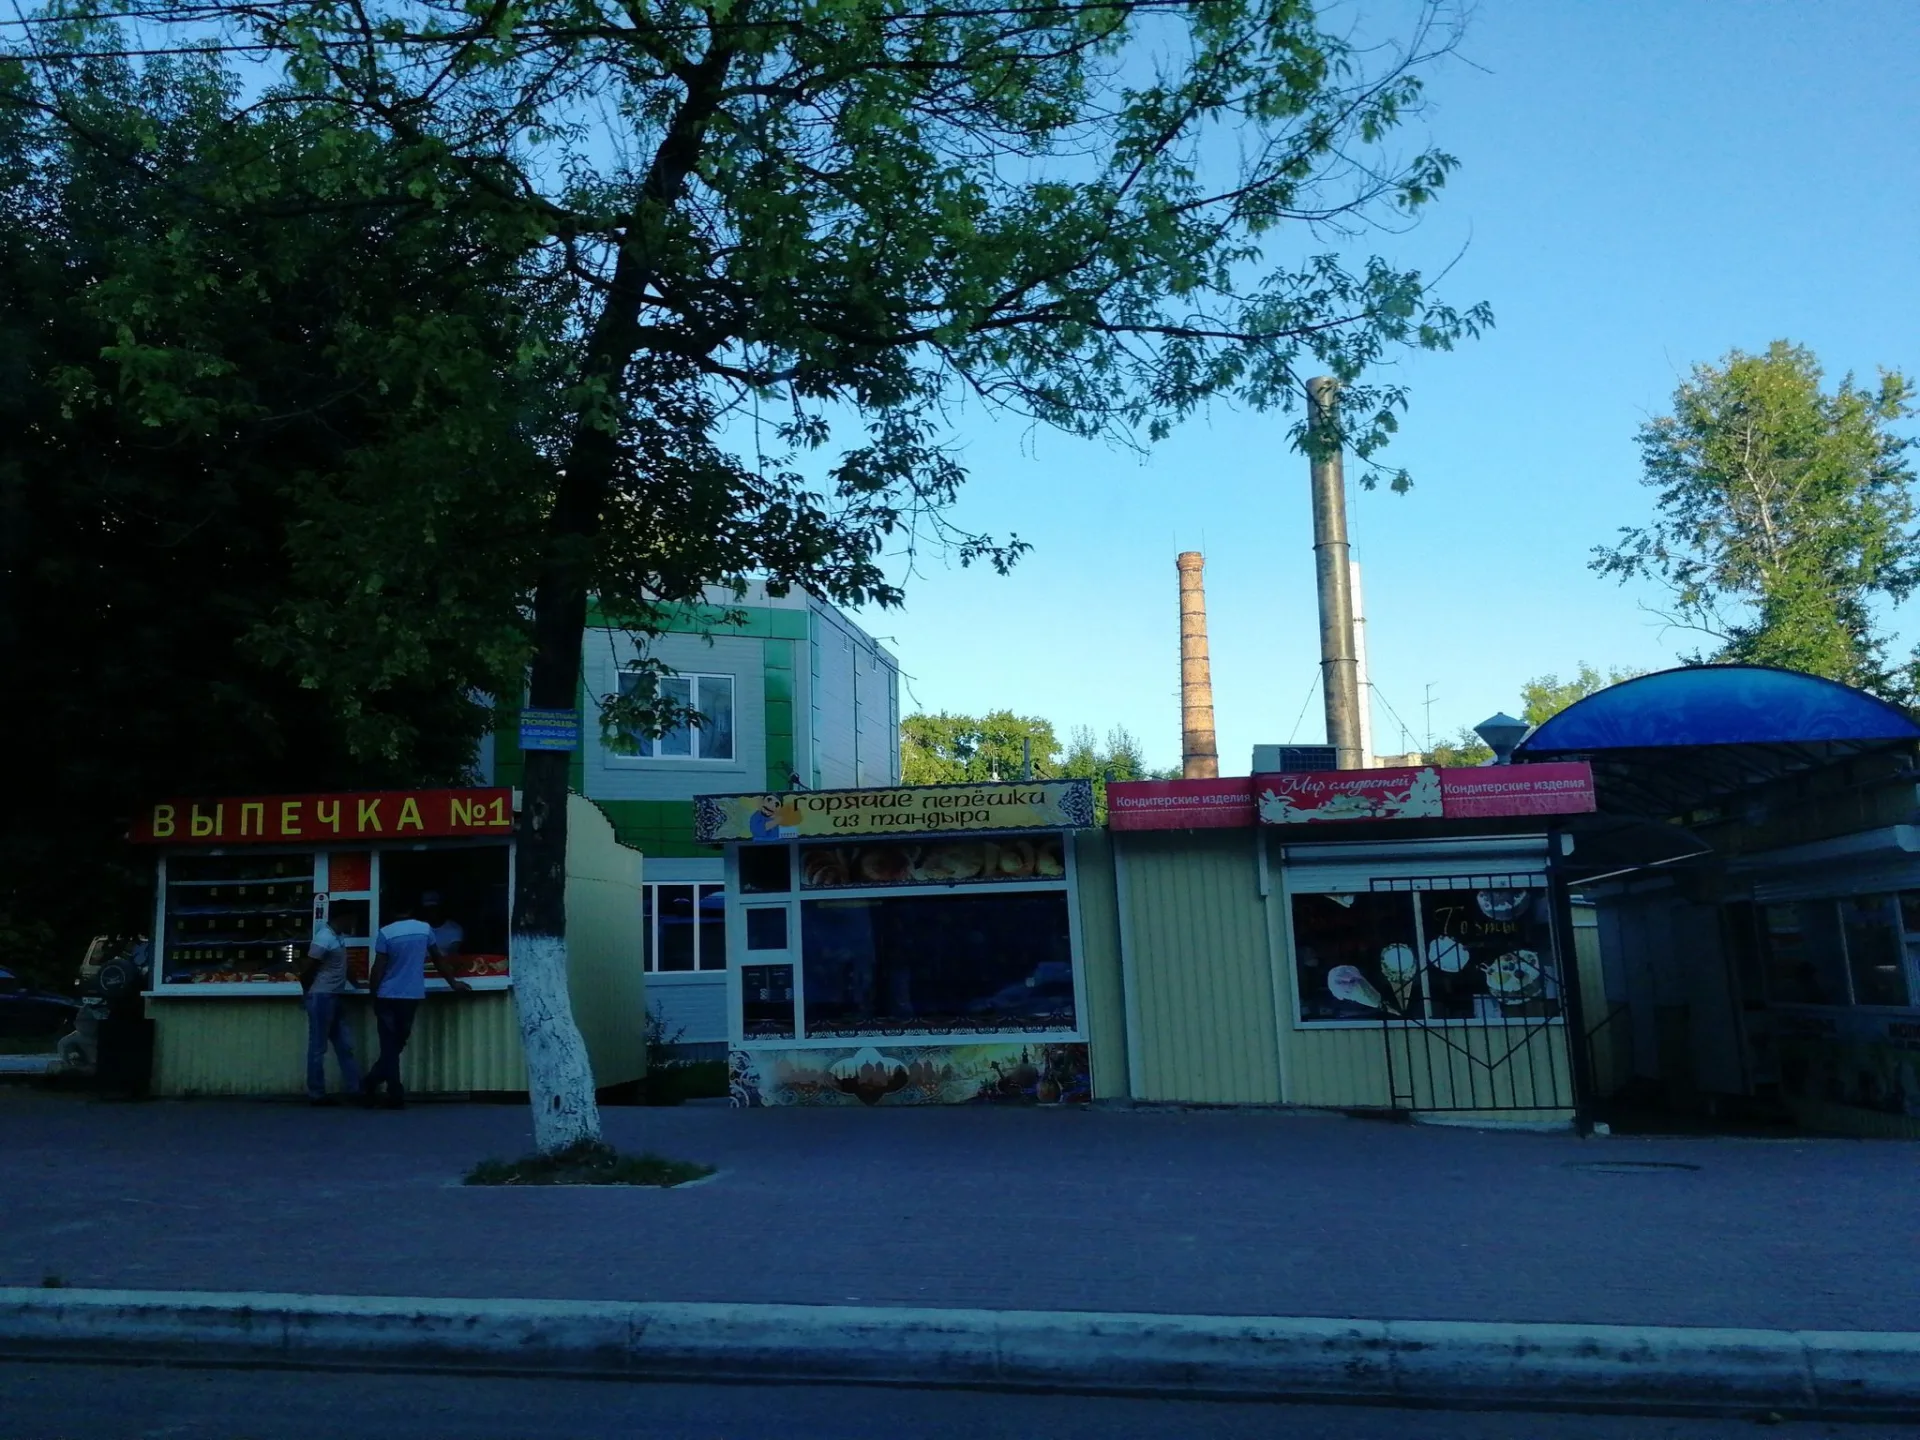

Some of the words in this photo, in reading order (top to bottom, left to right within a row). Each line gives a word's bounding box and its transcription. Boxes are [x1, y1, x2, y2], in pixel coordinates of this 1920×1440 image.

[1279, 775, 1326, 798] Мир
[1328, 773, 1411, 796] сладостей
[1443, 780, 1531, 794] Кондитерские
[1534, 779, 1586, 791] изделия
[922, 788, 1045, 809] лепёшки
[1116, 794, 1200, 807] Кондитерские
[1202, 793, 1251, 805] изделия
[153, 796, 424, 838] ВЫПЕЧКА
[449, 797, 511, 828] №1
[832, 814, 860, 828] из
[870, 809, 990, 829] тандыра
